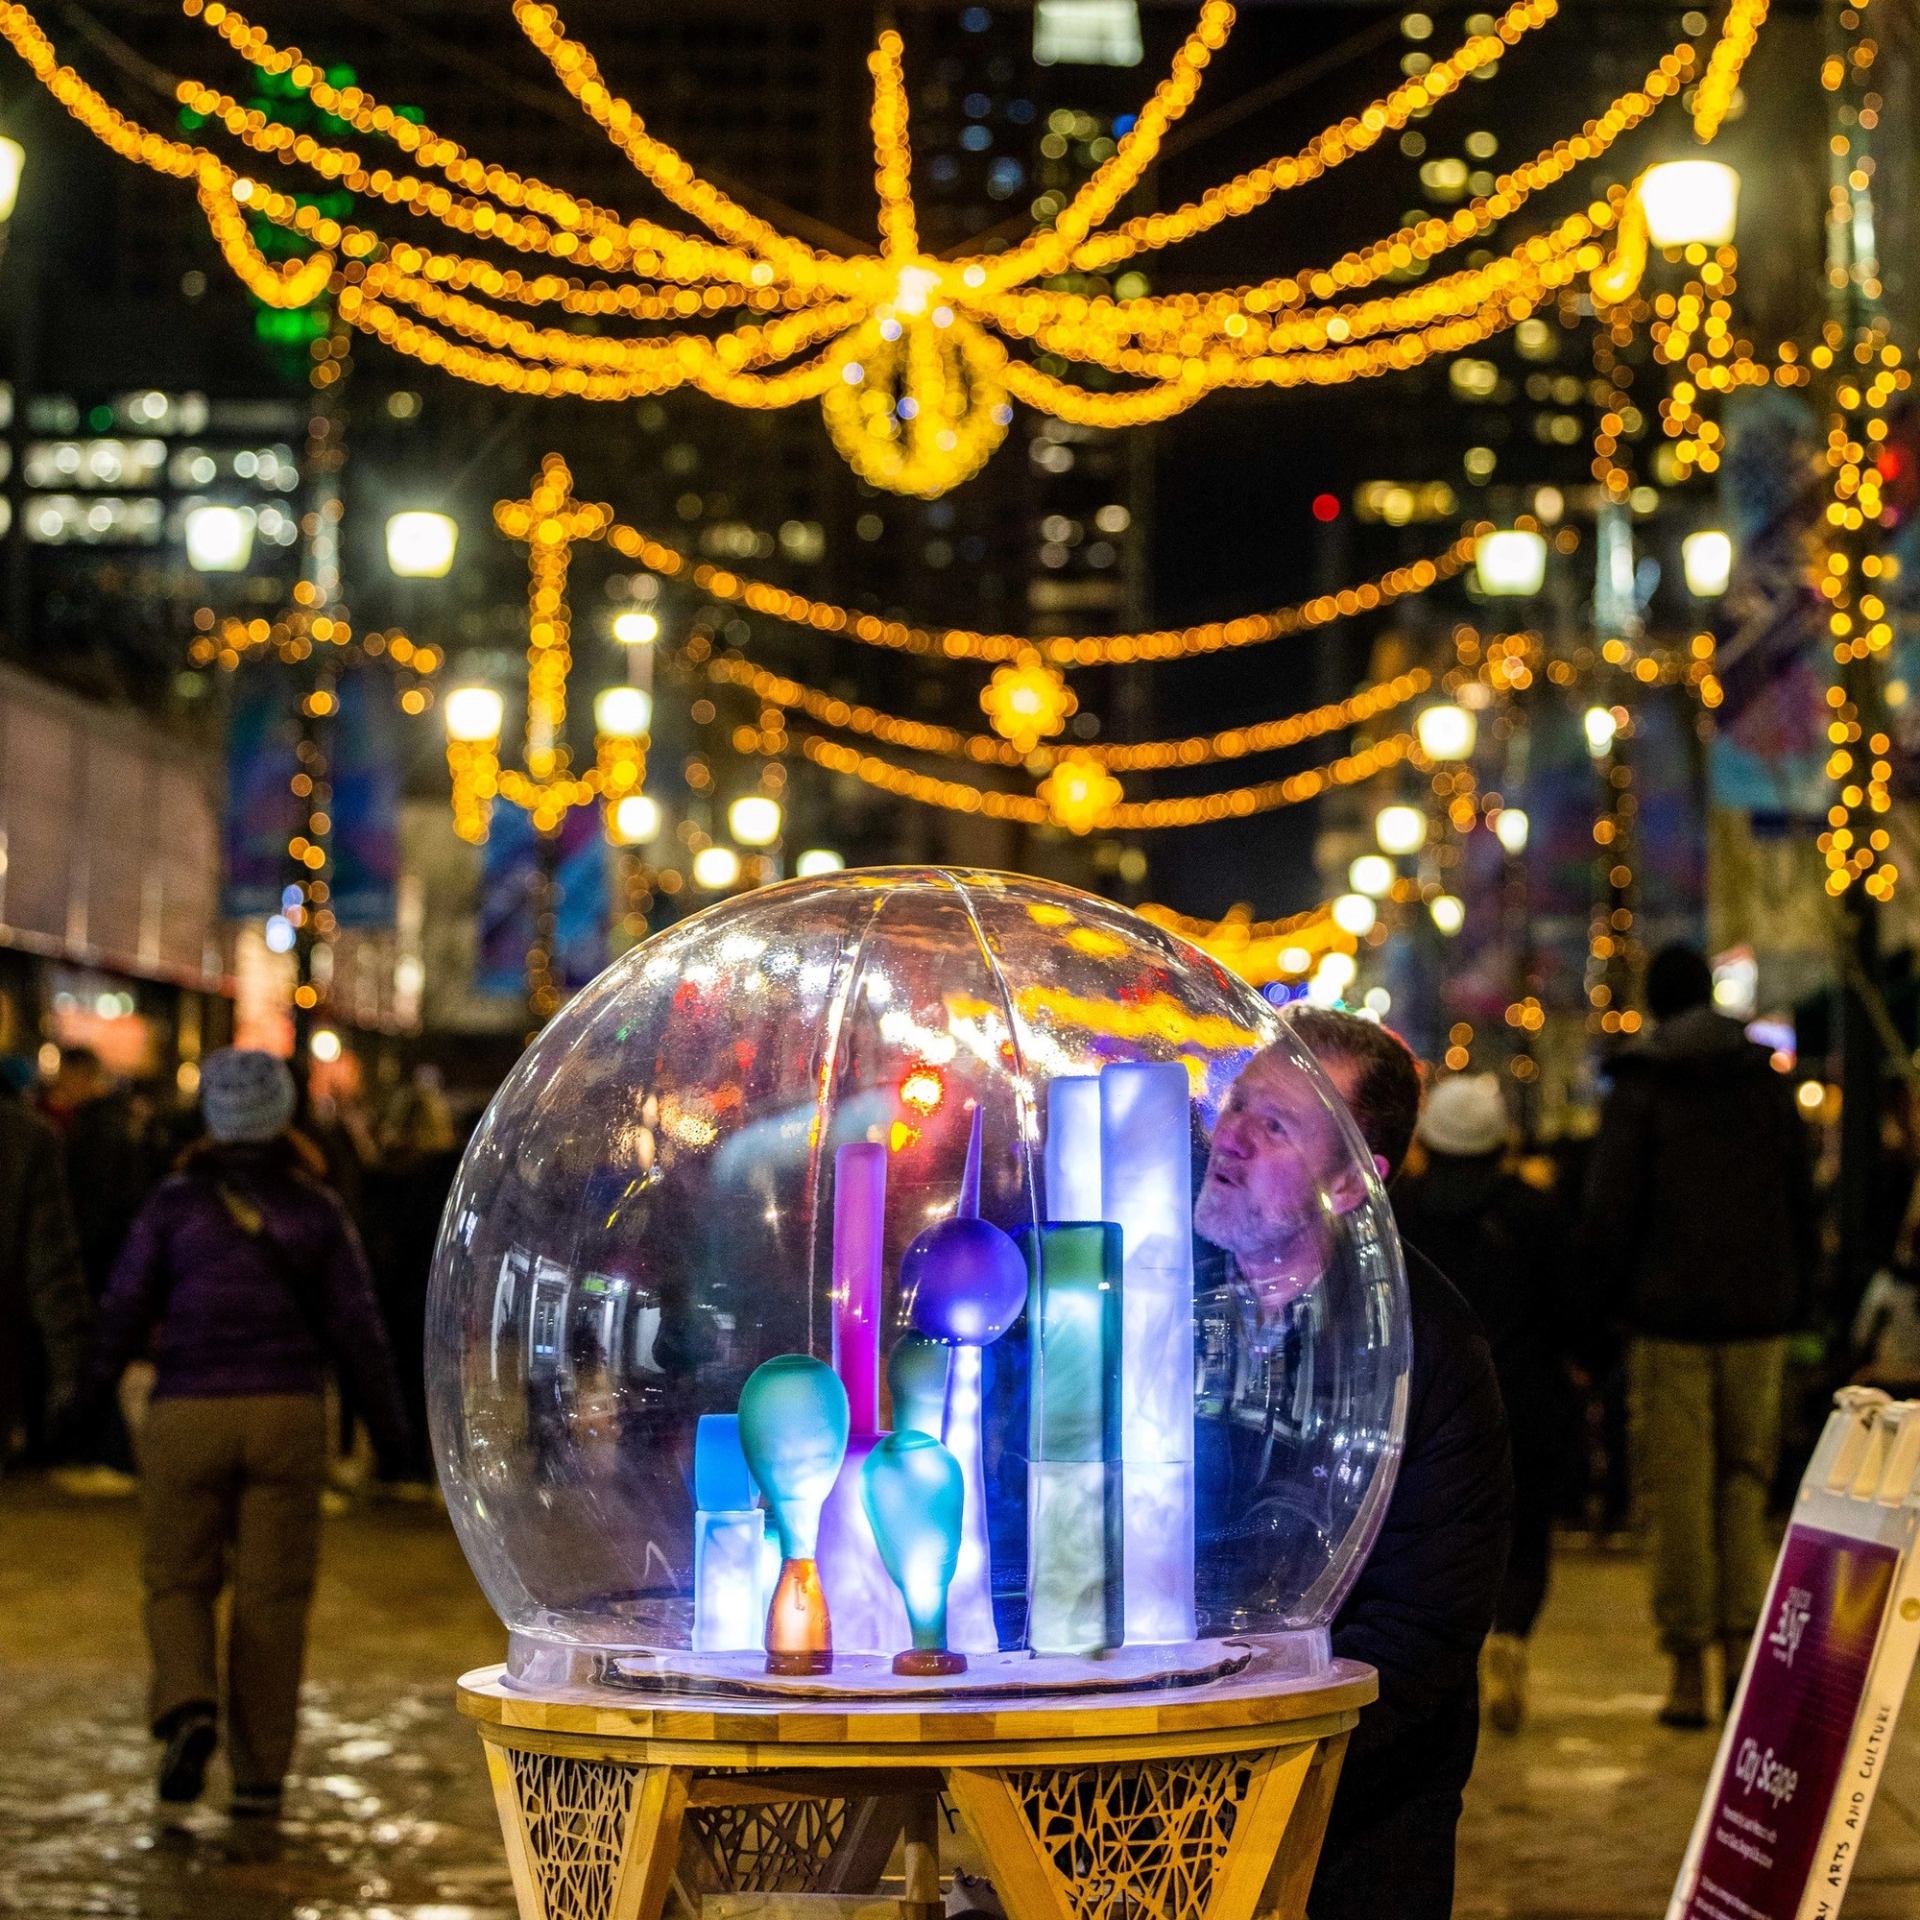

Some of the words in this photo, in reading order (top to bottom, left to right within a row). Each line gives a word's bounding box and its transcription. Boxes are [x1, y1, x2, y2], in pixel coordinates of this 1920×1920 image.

[1757, 1747, 1798, 1809] Scape
[1827, 1841, 1850, 1887] ARTS
[1845, 1791, 1865, 1829] AND
[1859, 1704, 1891, 1779] CULTURE
